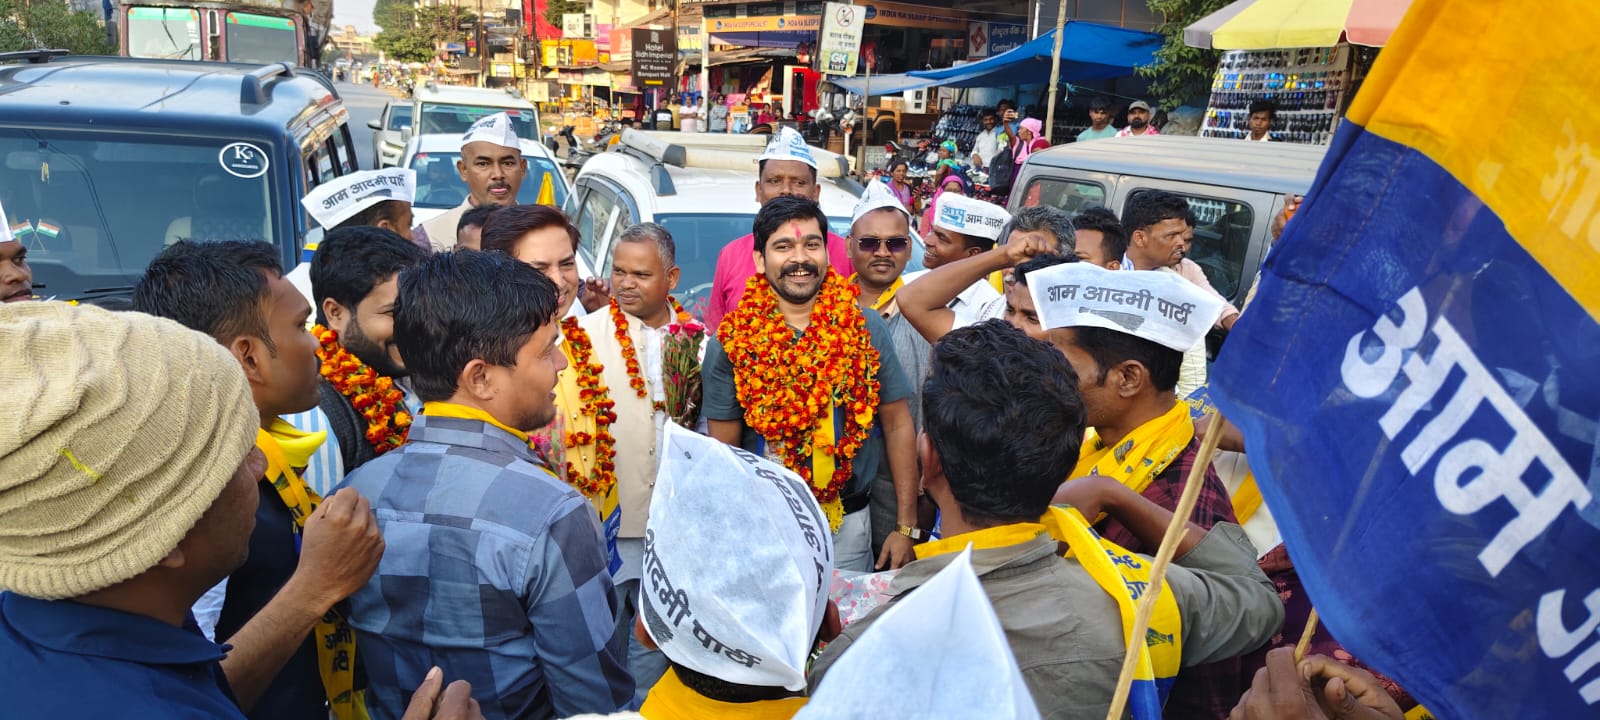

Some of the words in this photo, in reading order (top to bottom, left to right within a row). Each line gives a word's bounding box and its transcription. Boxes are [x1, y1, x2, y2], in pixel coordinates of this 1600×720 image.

[645, 43, 664, 52] Hotel
[649, 51, 674, 59] Imperial
[831, 52, 847, 64] GK
[322, 189, 350, 210] आम
[350, 175, 388, 195] आदमी
[965, 212, 984, 226] आम
[1047, 284, 1081, 302] आम
[1083, 285, 1155, 312] आदमी
[1157, 297, 1197, 326] पार्टी
[1340, 285, 1593, 578] आम
[693, 619, 763, 670] पार्टी
